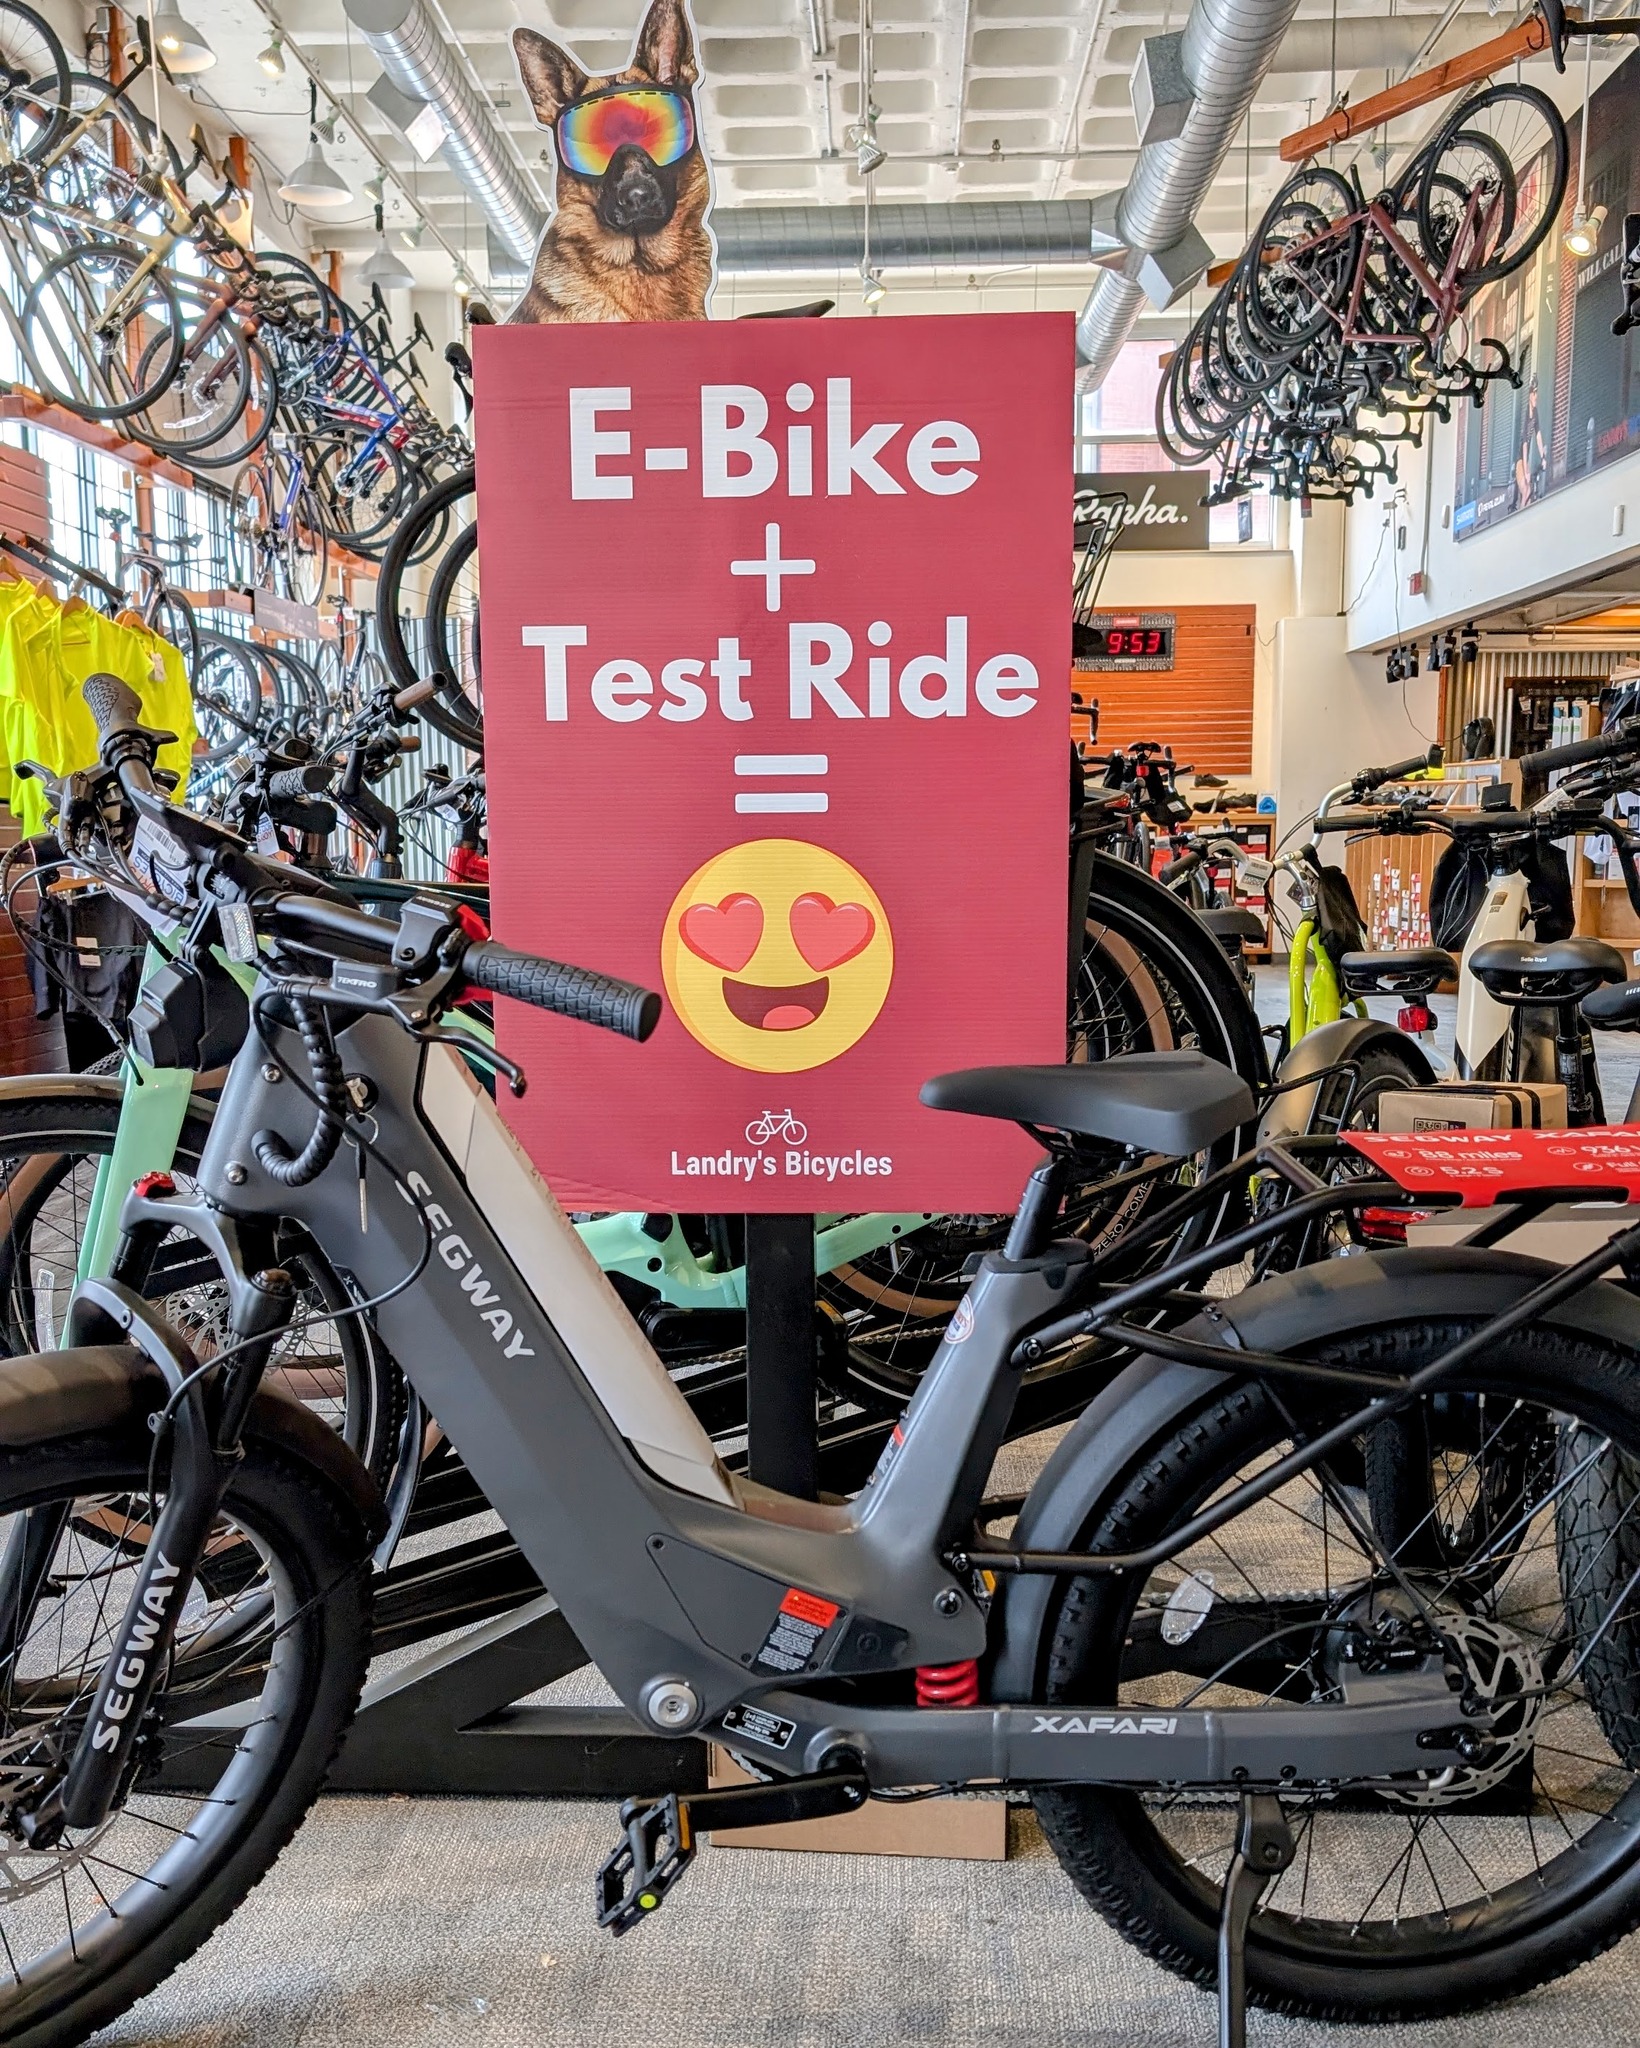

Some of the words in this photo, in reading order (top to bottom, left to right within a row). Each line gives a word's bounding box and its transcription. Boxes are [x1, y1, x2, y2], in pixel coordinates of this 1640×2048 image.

[569, 377, 981, 500] E-Bike
[1107, 632, 1161, 654] 9:53
[521, 625, 754, 722] Test
[788, 615, 1040, 720] Ride
[133, 855, 185, 903] BICYCES
[337, 976, 378, 988] TEKTRO
[1364, 1134, 1512, 1143] SEGWAY
[1533, 1131, 1640, 1139] XAFA
[671, 1149, 778, 1182] Landry's
[785, 1149, 893, 1182] Bicycles
[1418, 1150, 1454, 1159] 88
[1457, 1150, 1523, 1159] miles
[395, 1170, 536, 1359] SEGWAY
[91, 1551, 180, 1753] SEGWAY
[1030, 1716, 1178, 1735] XAFARI
